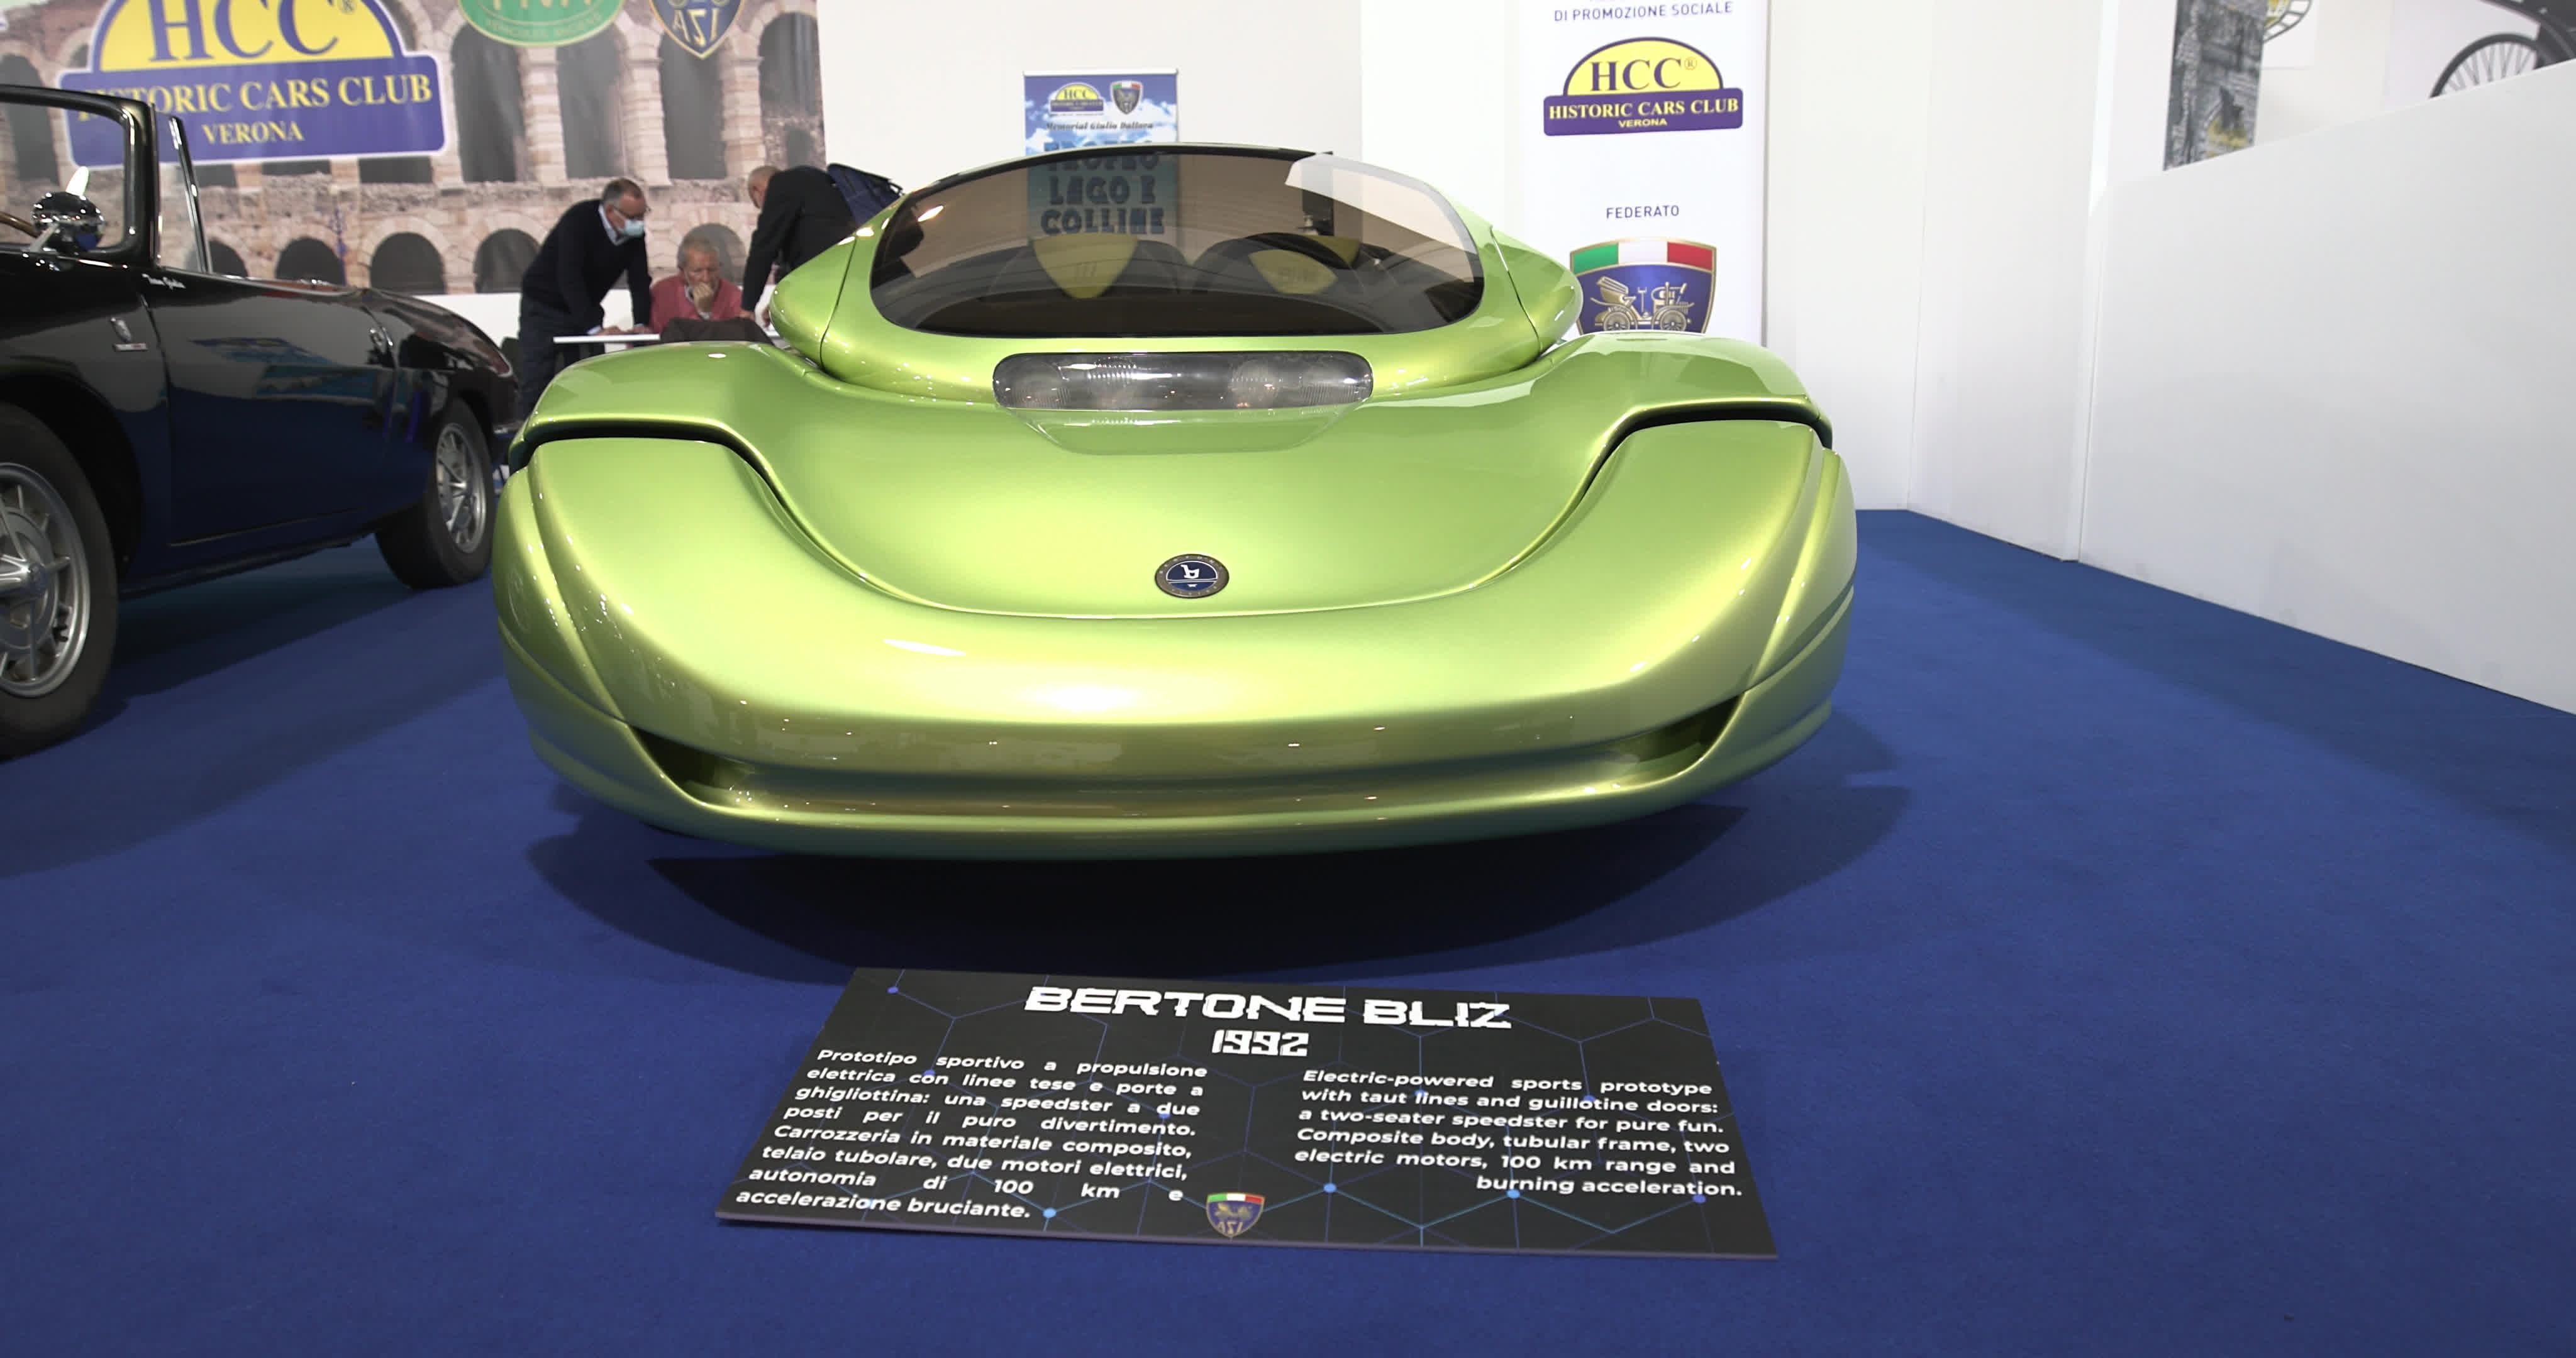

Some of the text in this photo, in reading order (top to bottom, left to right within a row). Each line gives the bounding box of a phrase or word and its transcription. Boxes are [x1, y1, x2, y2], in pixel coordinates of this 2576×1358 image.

[1554, 1, 1733, 21] DI PROMOZIONE SOCIALE
[239, 78, 330, 113] CARS
[339, 74, 433, 105] CLUB
[1549, 97, 1739, 119] HISTORIC CARS CLUB
[203, 121, 305, 145] VERONA
[1046, 121, 1088, 130] Memorial
[1618, 118, 1667, 128] VERONA
[1049, 175, 1156, 204] LAGO E
[1041, 207, 1165, 235] COLLINE
[1606, 206, 1680, 219] FEDERATO
[1023, 985, 1513, 1029] BERTONE BLIZ
[1211, 1029, 1310, 1057] 1992
[816, 1049, 1208, 1078] Prototipo sportivo a propulsione
[806, 1066, 1204, 1097] elettrica con linee tese e porte a
[1302, 1069, 1713, 1097] Electric-powered sports prototype
[794, 1085, 1201, 1117] ghigliottina: una speedster a due
[1301, 1088, 1718, 1114] with taut lines and guillotine doors:
[782, 1105, 1196, 1137] posti per il puro divertimento.
[1298, 1108, 1724, 1134] a two-seater speedster for pure fun.
[774, 1124, 1192, 1160] Carrozzeria in materiale composito,
[1296, 1127, 1730, 1154] Composite body, tubular frame, two
[762, 1145, 1188, 1182] telaio tubolare, due motori elettrici,
[1294, 1147, 1736, 1176] electric motors, 100 km range and
[748, 1168, 1184, 1202] autonomia di 100 km e
[1475, 1174, 1743, 1196] burning acceleration.
[735, 1191, 1031, 1218] accelerazione bruciante.
